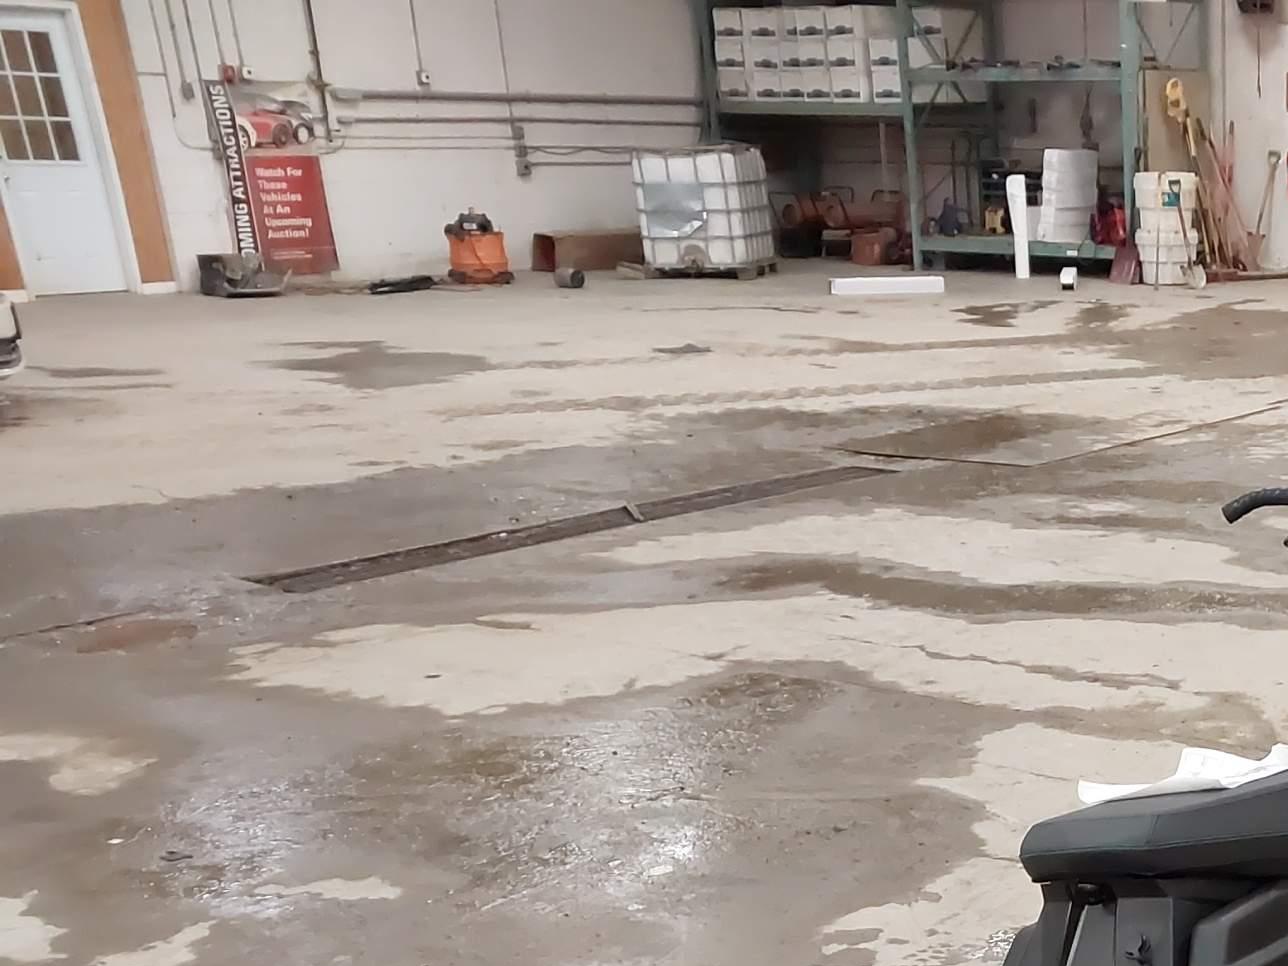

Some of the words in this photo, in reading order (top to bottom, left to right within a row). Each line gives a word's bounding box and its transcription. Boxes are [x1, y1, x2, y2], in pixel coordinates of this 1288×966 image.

[210, 84, 246, 199] ATTRACTIONS
[255, 167, 285, 177] Watch
[287, 167, 303, 177] For
[258, 180, 288, 189] These
[260, 192, 302, 202] Vehicles
[263, 205, 274, 214] At
[276, 204, 291, 214] An
[265, 215, 313, 228] Upcoming
[235, 203, 256, 258] OMING
[267, 228, 310, 239] Auction!
